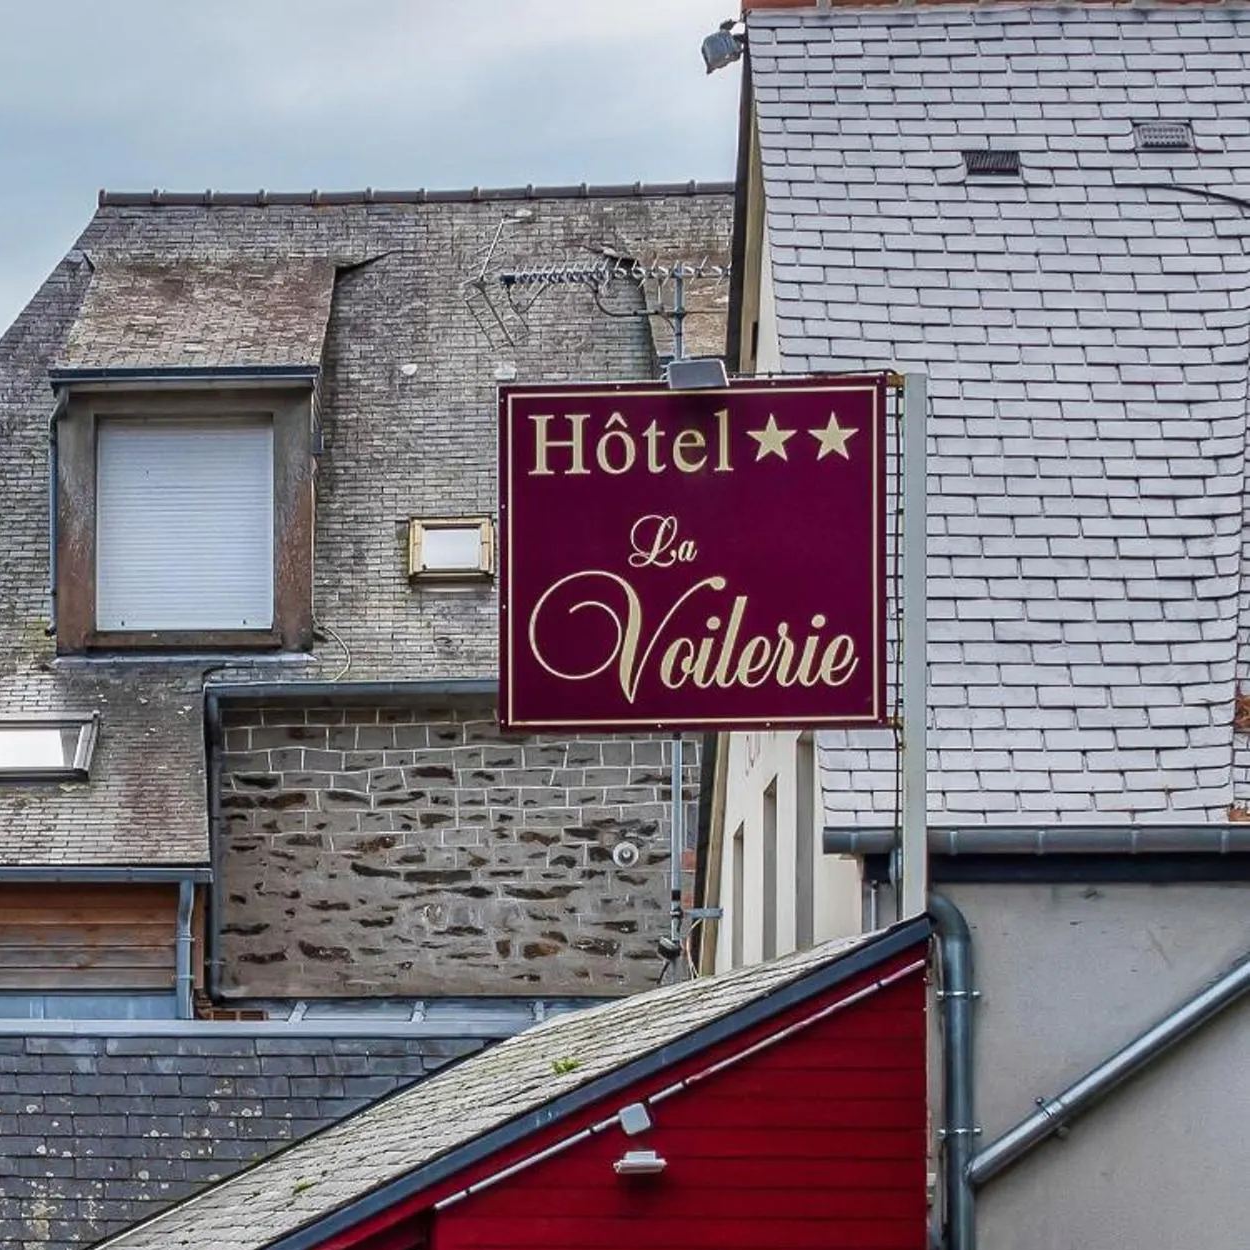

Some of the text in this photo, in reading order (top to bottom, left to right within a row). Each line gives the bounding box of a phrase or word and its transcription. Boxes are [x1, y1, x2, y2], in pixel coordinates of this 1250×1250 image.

[528, 409, 734, 476] Hôtel
[628, 514, 698, 568] La
[528, 570, 860, 704] Voilerie
